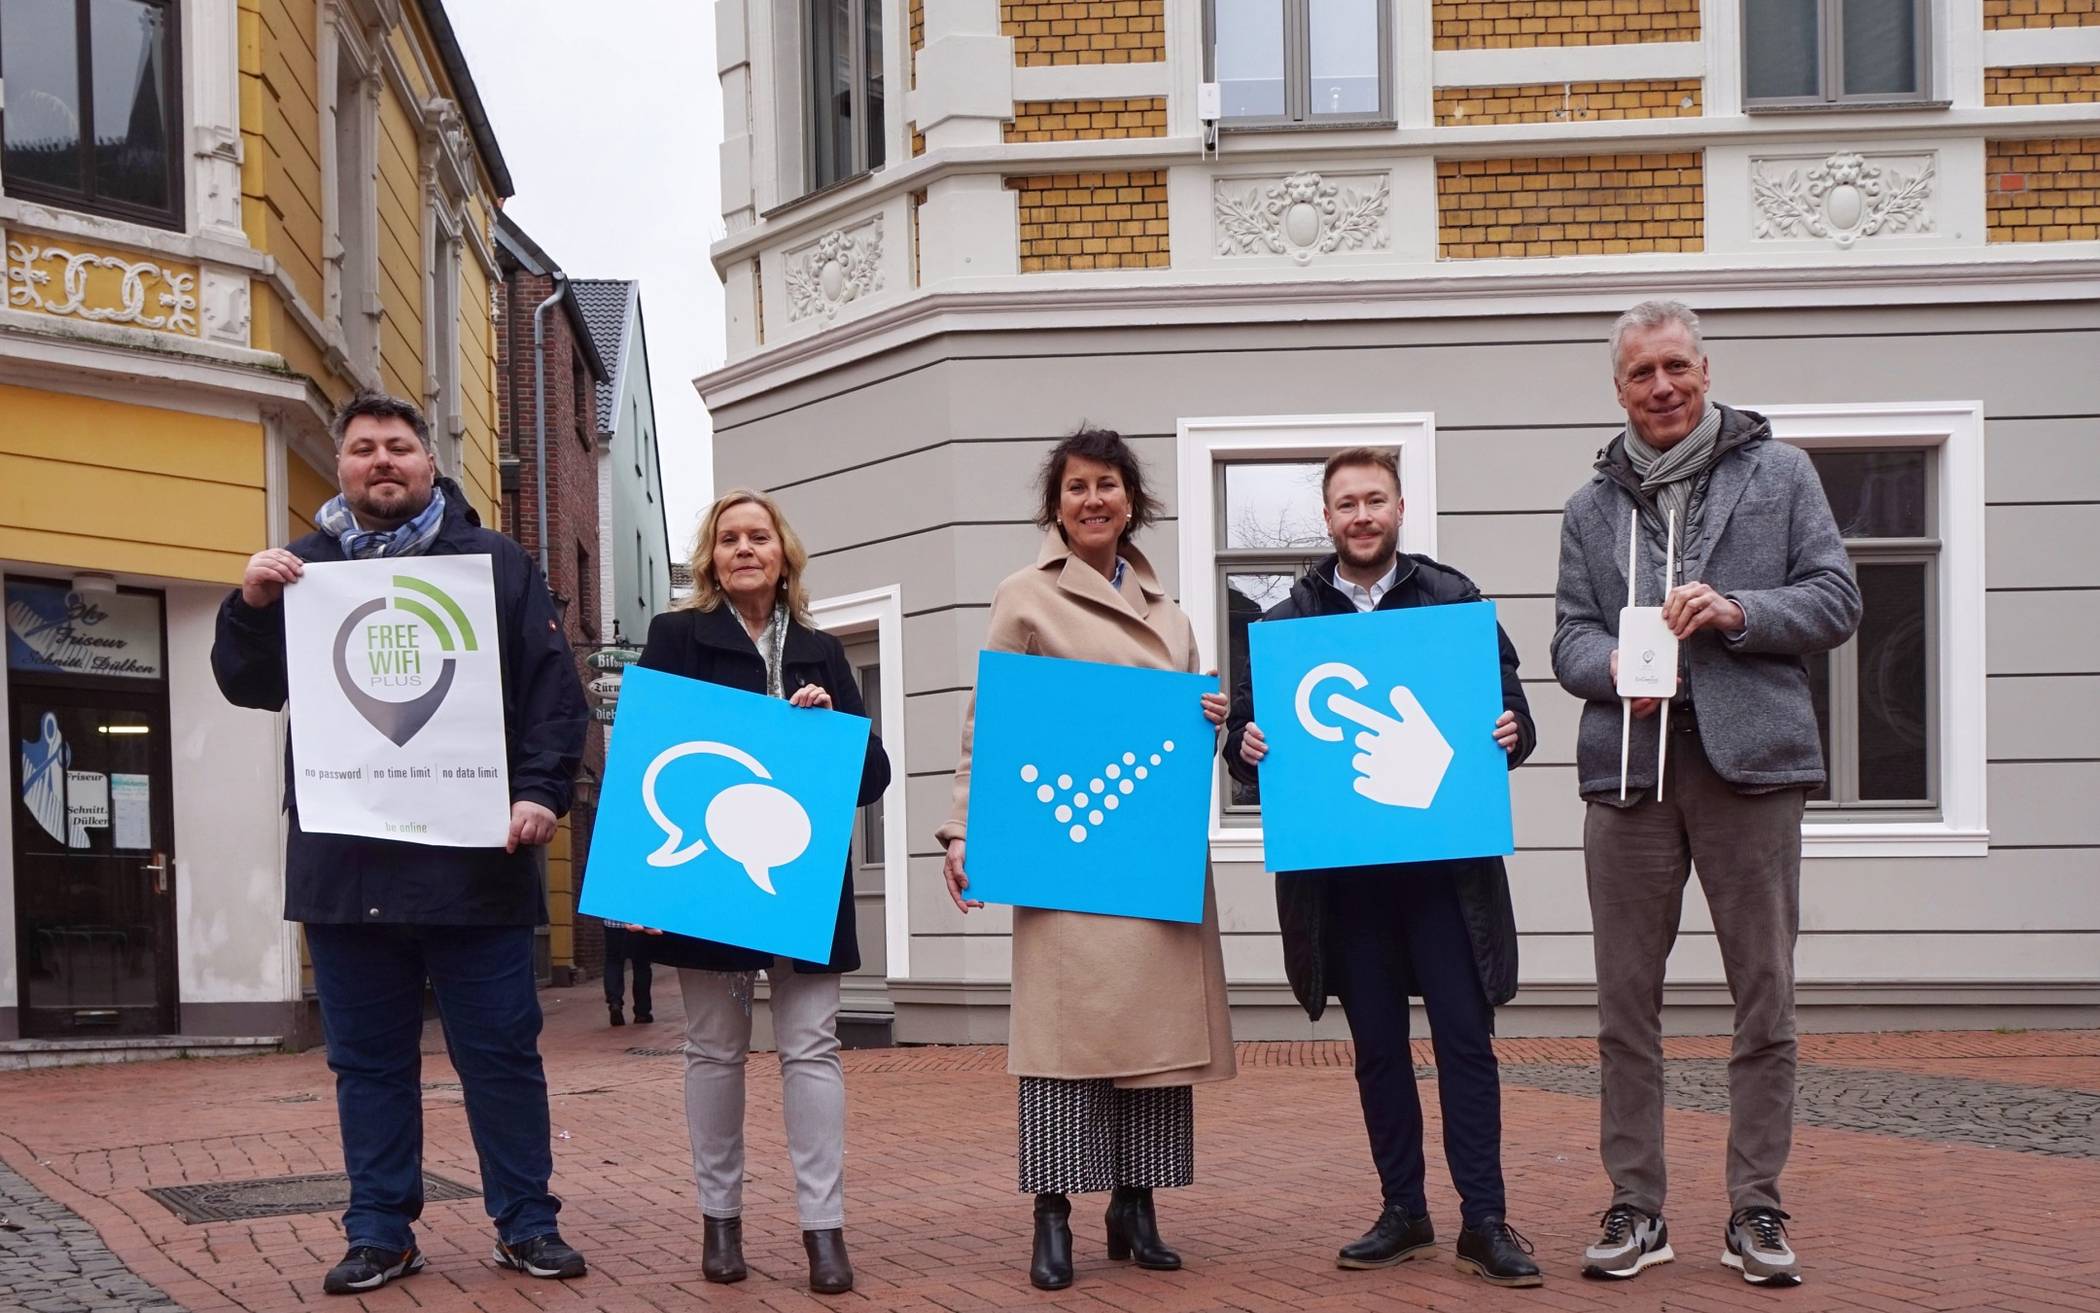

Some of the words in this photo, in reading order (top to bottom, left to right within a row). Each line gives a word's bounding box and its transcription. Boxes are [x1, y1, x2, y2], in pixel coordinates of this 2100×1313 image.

[56, 626, 127, 649] Friseur
[367, 624, 419, 649] FREE
[91, 656, 155, 673] Dülken
[369, 650, 420, 675] WIFI
[370, 675, 422, 687] PLUS
[305, 768, 316, 778] no
[319, 767, 361, 780] password
[374, 769, 385, 779] no
[387, 766, 407, 779] time
[410, 766, 431, 779] limit
[442, 769, 453, 779] no
[456, 766, 476, 779] data
[477, 766, 498, 779] limit
[385, 821, 396, 833] be
[399, 821, 427, 833] online
